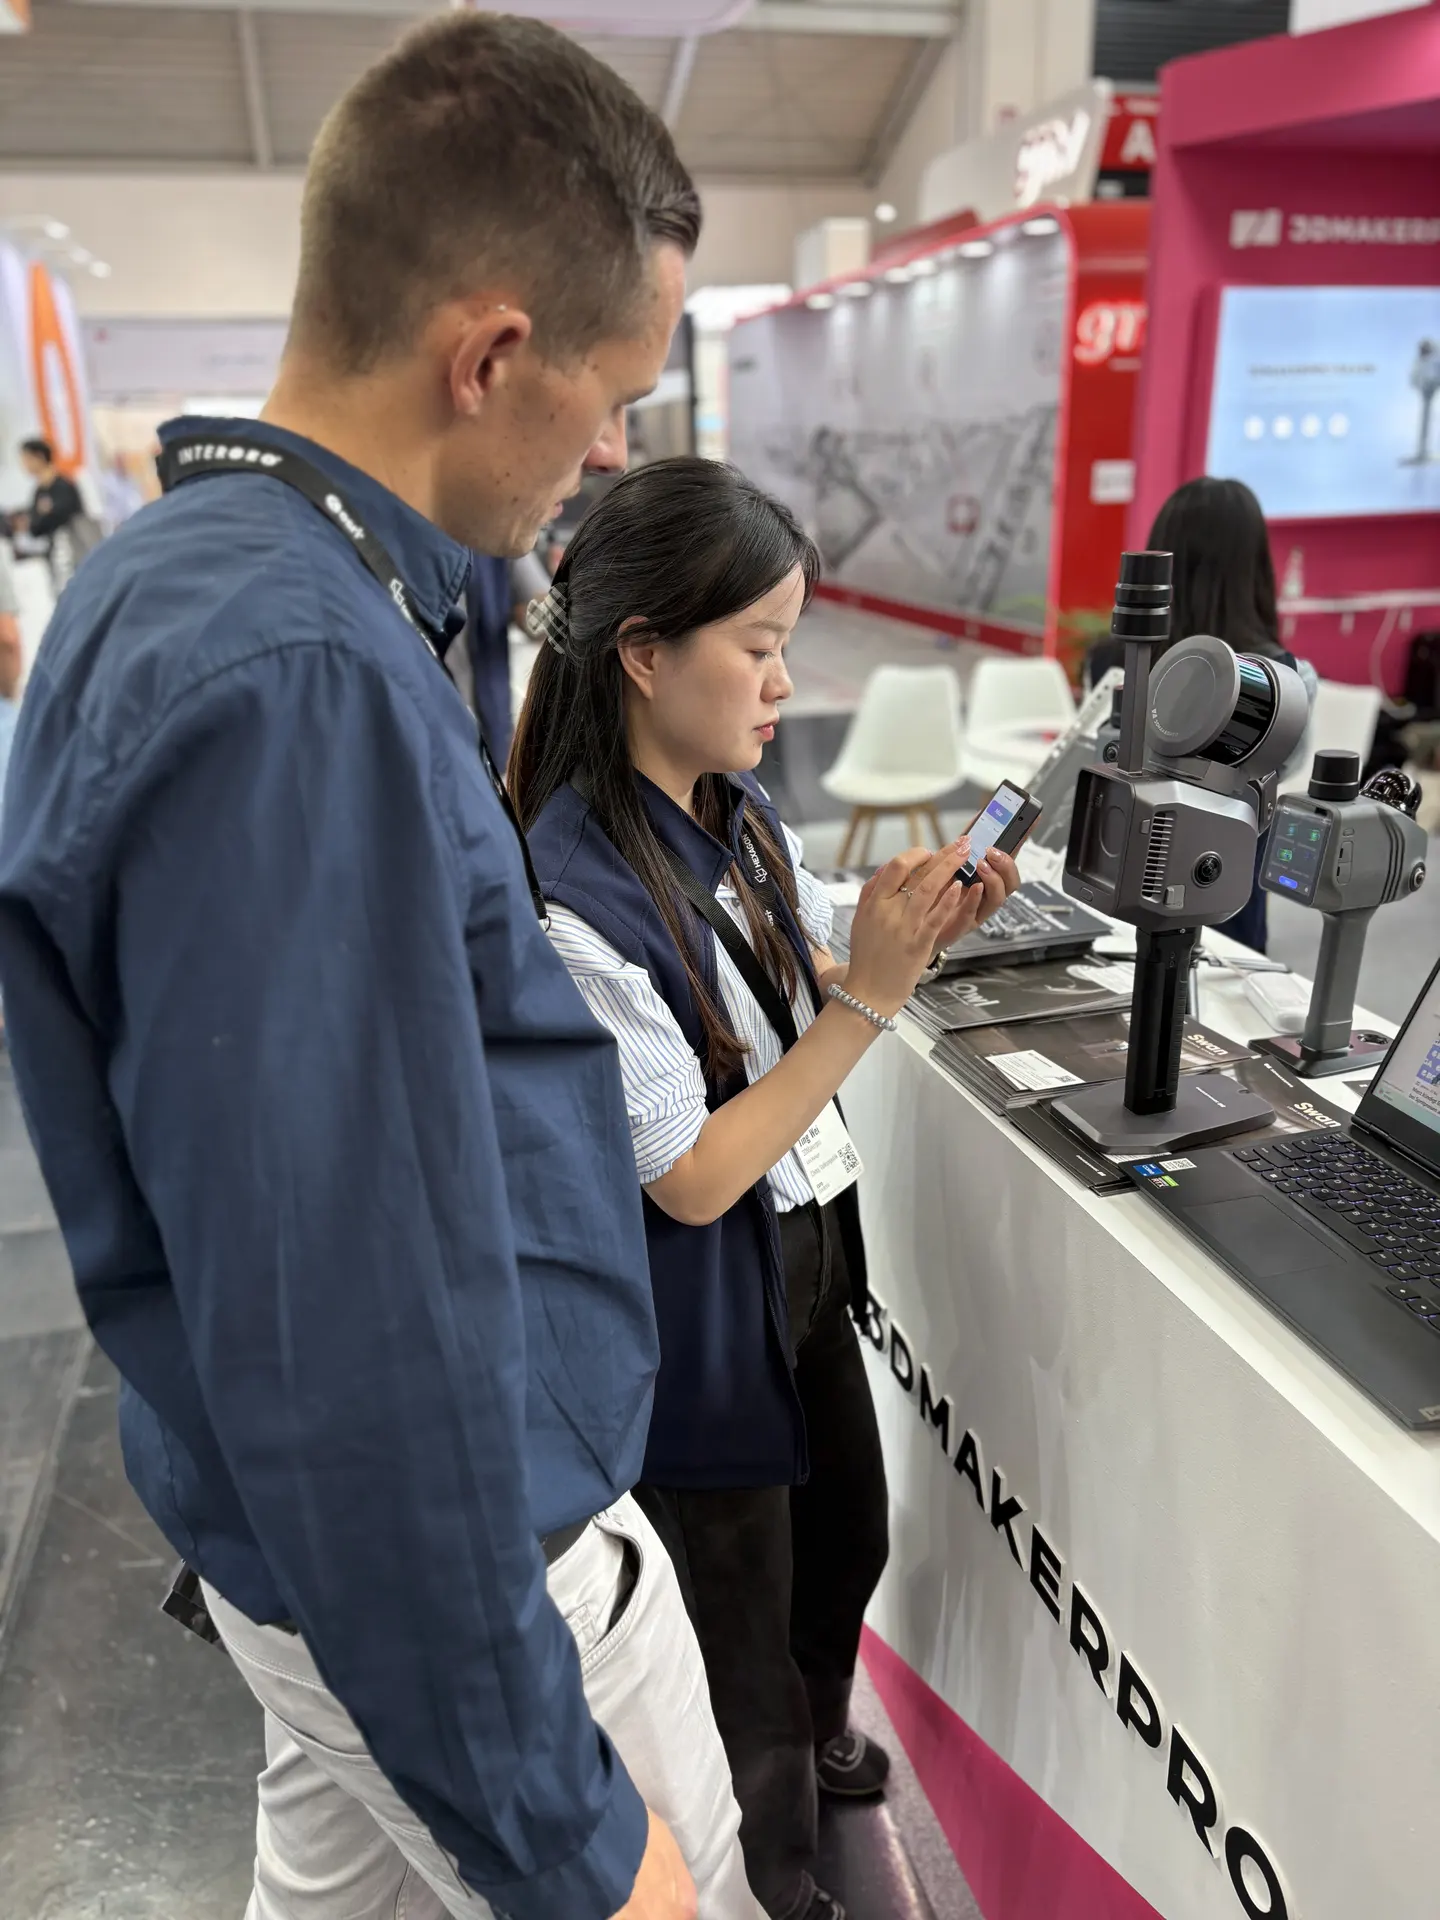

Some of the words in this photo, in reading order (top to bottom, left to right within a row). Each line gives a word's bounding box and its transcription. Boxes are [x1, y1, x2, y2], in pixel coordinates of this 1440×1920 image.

[742, 833, 762, 869] HEXAGON
[1187, 1034, 1229, 1056] Swan
[1294, 1102, 1342, 1128] Swan
[860, 1289, 1290, 1920] 3DMAKERPRO
